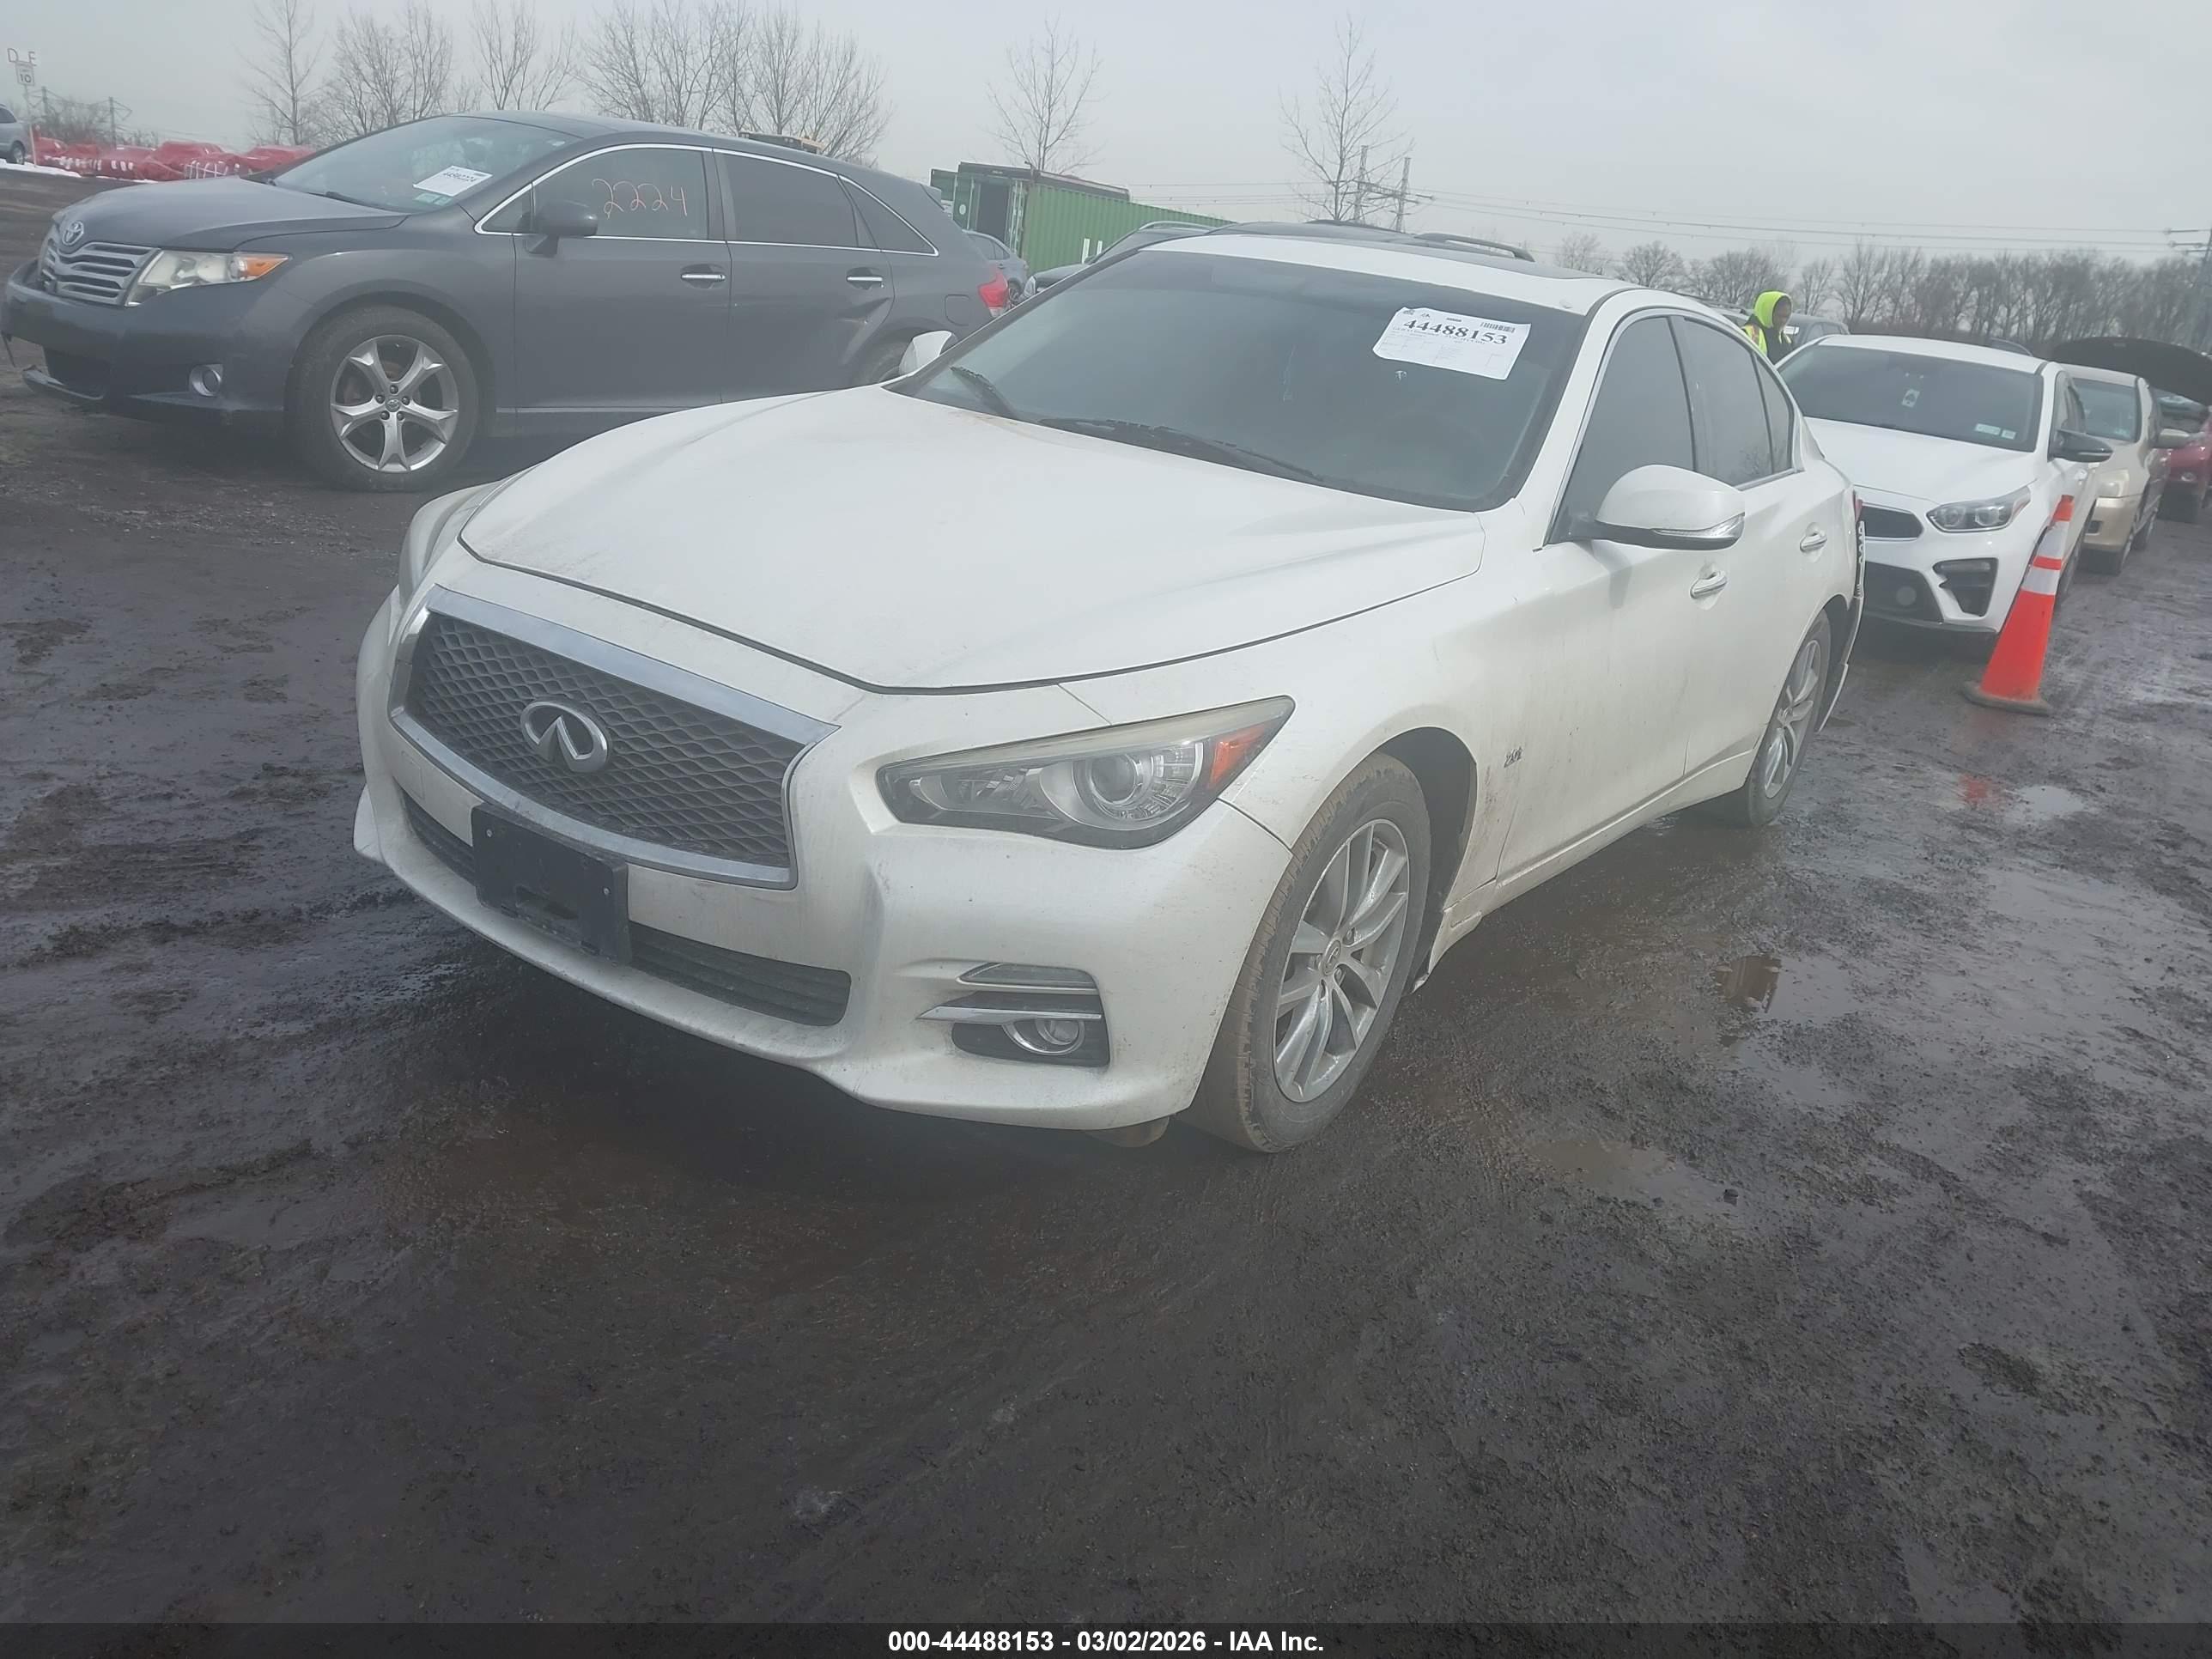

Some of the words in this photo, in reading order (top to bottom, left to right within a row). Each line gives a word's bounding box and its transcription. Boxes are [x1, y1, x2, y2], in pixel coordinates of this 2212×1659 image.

[20, 74, 32, 83] 10
[592, 178, 688, 220] 2224
[1403, 319, 1508, 344] 44488153
